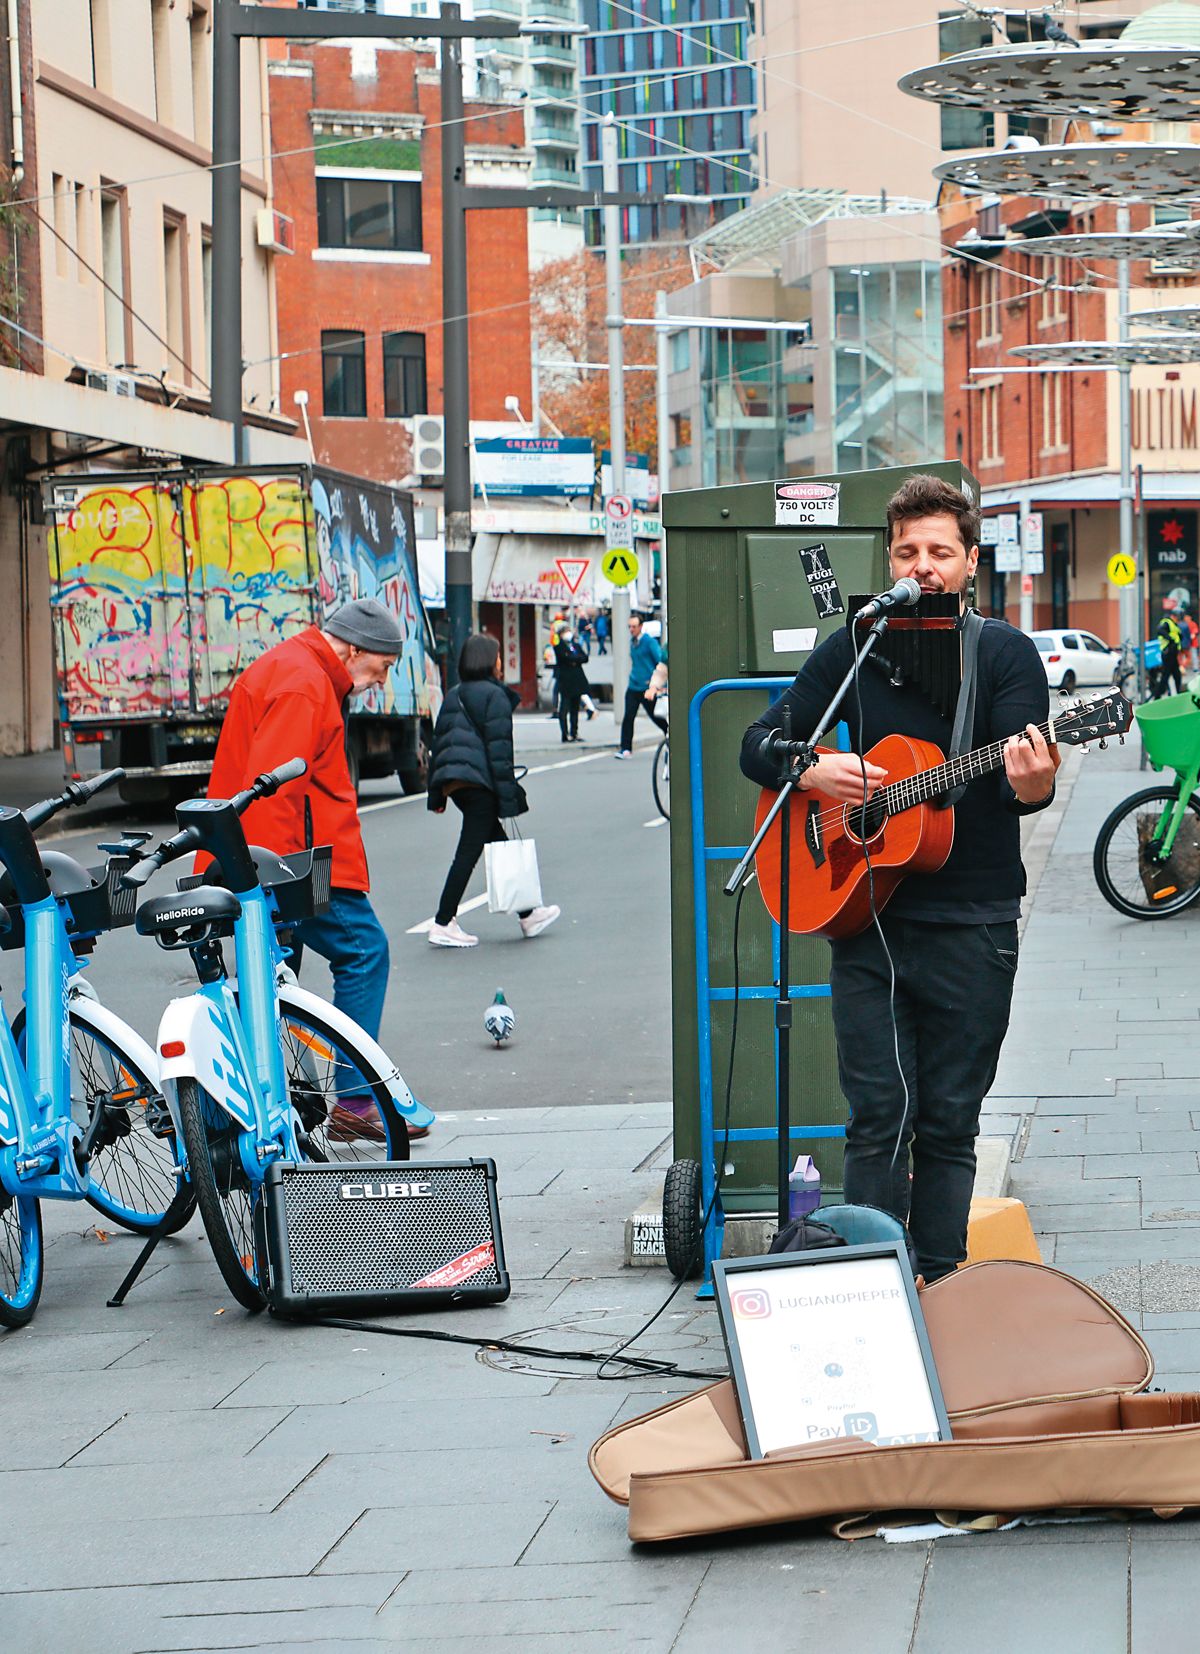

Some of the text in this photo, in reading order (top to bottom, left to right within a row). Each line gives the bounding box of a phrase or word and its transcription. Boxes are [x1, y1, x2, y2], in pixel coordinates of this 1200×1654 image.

[506, 440, 559, 449] CREATIVE
[786, 488, 828, 496] DANGER
[780, 501, 834, 510] 750 VOLTS
[800, 514, 815, 522] DC
[1158, 549, 1187, 563] nab
[807, 568, 835, 583] FUGI
[811, 580, 837, 594] FUGI
[156, 906, 205, 923] HelloRide
[341, 1182, 433, 1199] CUBE
[778, 1288, 901, 1309] LUCIANOPIEPER
[806, 1423, 842, 1440] Pay
